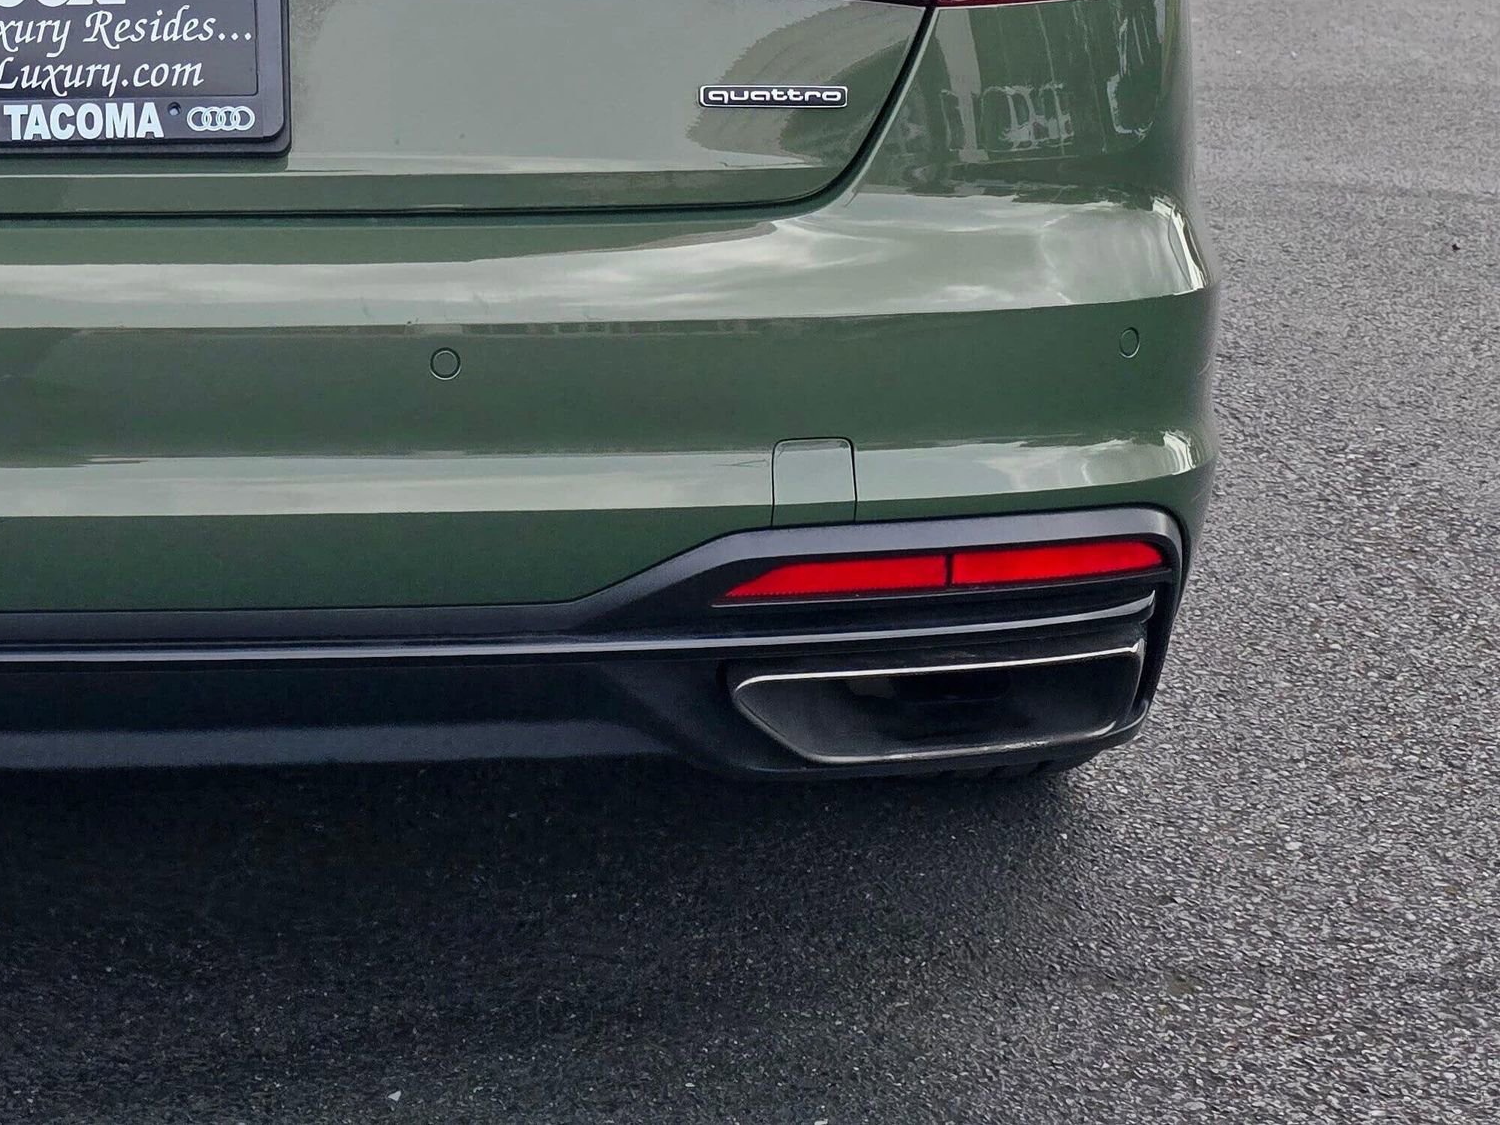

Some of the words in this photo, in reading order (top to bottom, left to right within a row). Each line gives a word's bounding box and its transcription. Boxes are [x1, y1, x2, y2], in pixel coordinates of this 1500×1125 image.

[82, 5, 252, 49] Resides...
[708, 88, 842, 104] quattro
[3, 102, 165, 141] TACOMA
